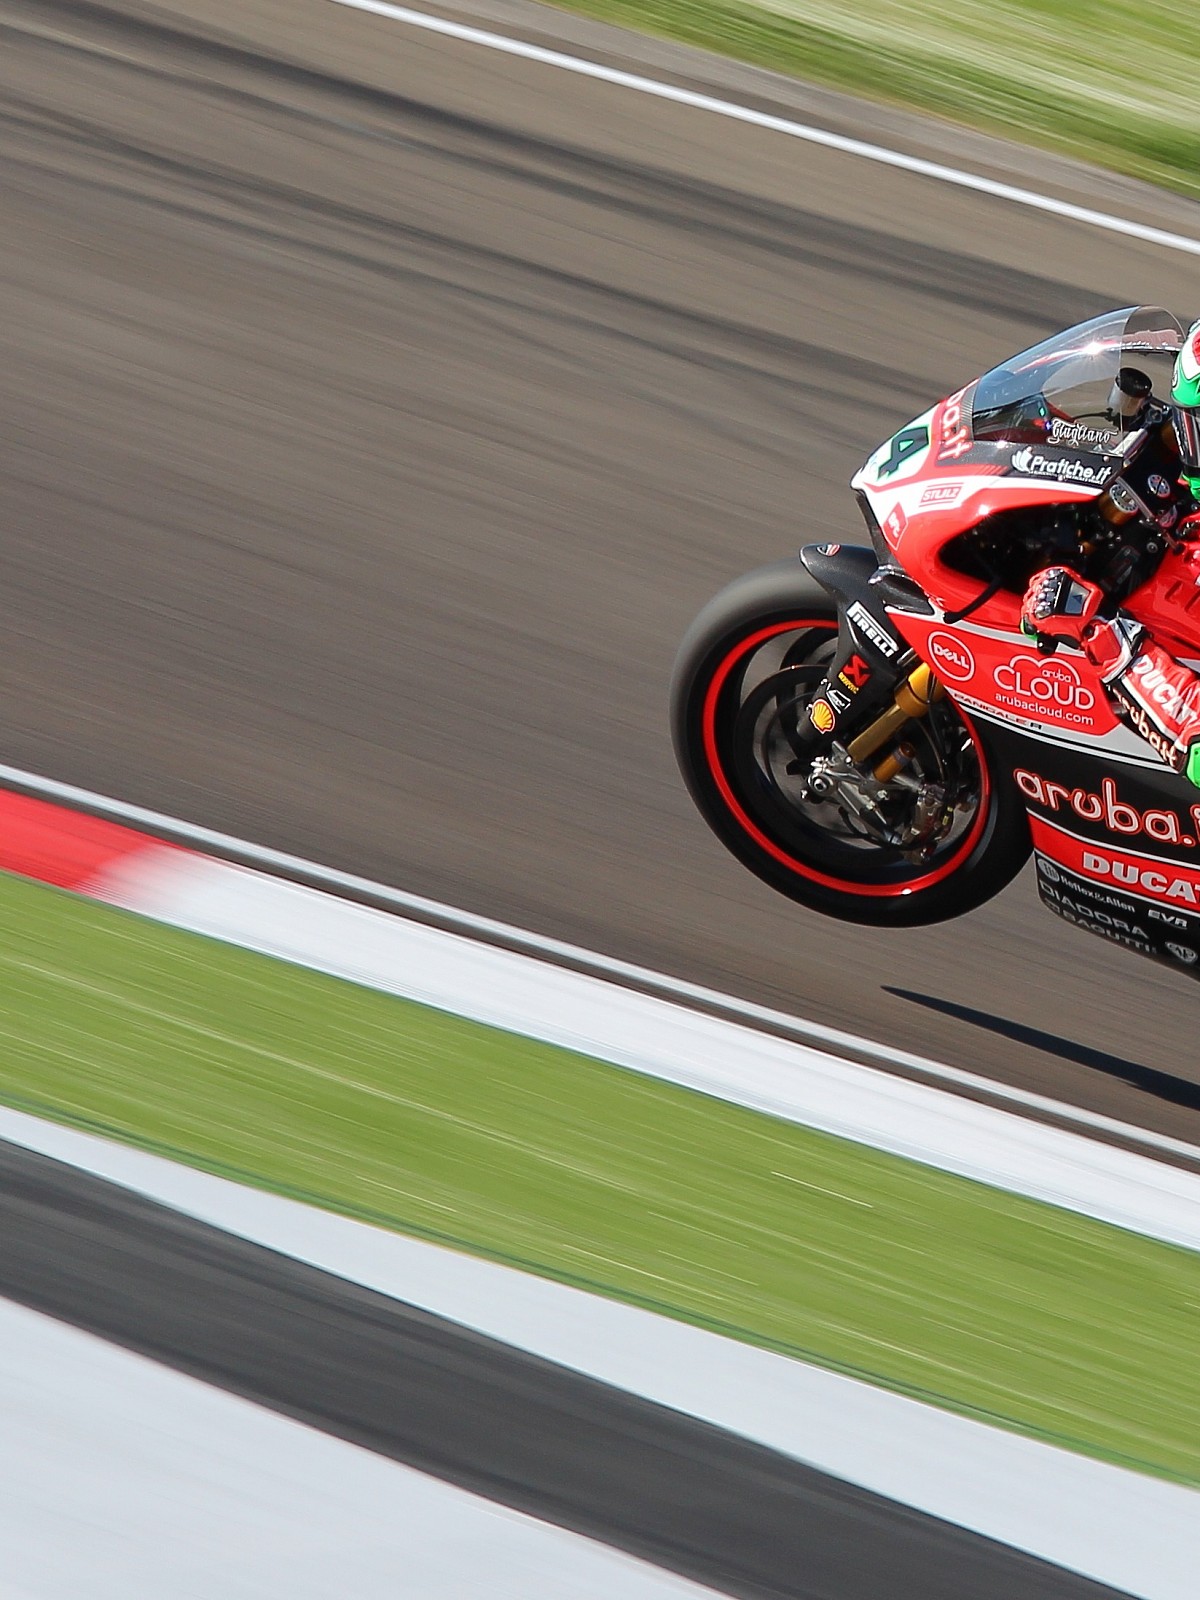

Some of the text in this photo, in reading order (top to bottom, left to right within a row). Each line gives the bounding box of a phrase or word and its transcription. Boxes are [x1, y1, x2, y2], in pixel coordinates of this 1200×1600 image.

[877, 425, 930, 481] 4
[1031, 456, 1112, 484] Pratiche.it
[924, 487, 959, 500] STULZ
[847, 600, 898, 657] PIRELLI
[934, 643, 969, 669] DELL
[993, 665, 1095, 710] CLOUD
[1042, 669, 1071, 683] aruba
[995, 693, 1094, 726] arubacloud.com
[1040, 880, 1149, 939] DIADORA
